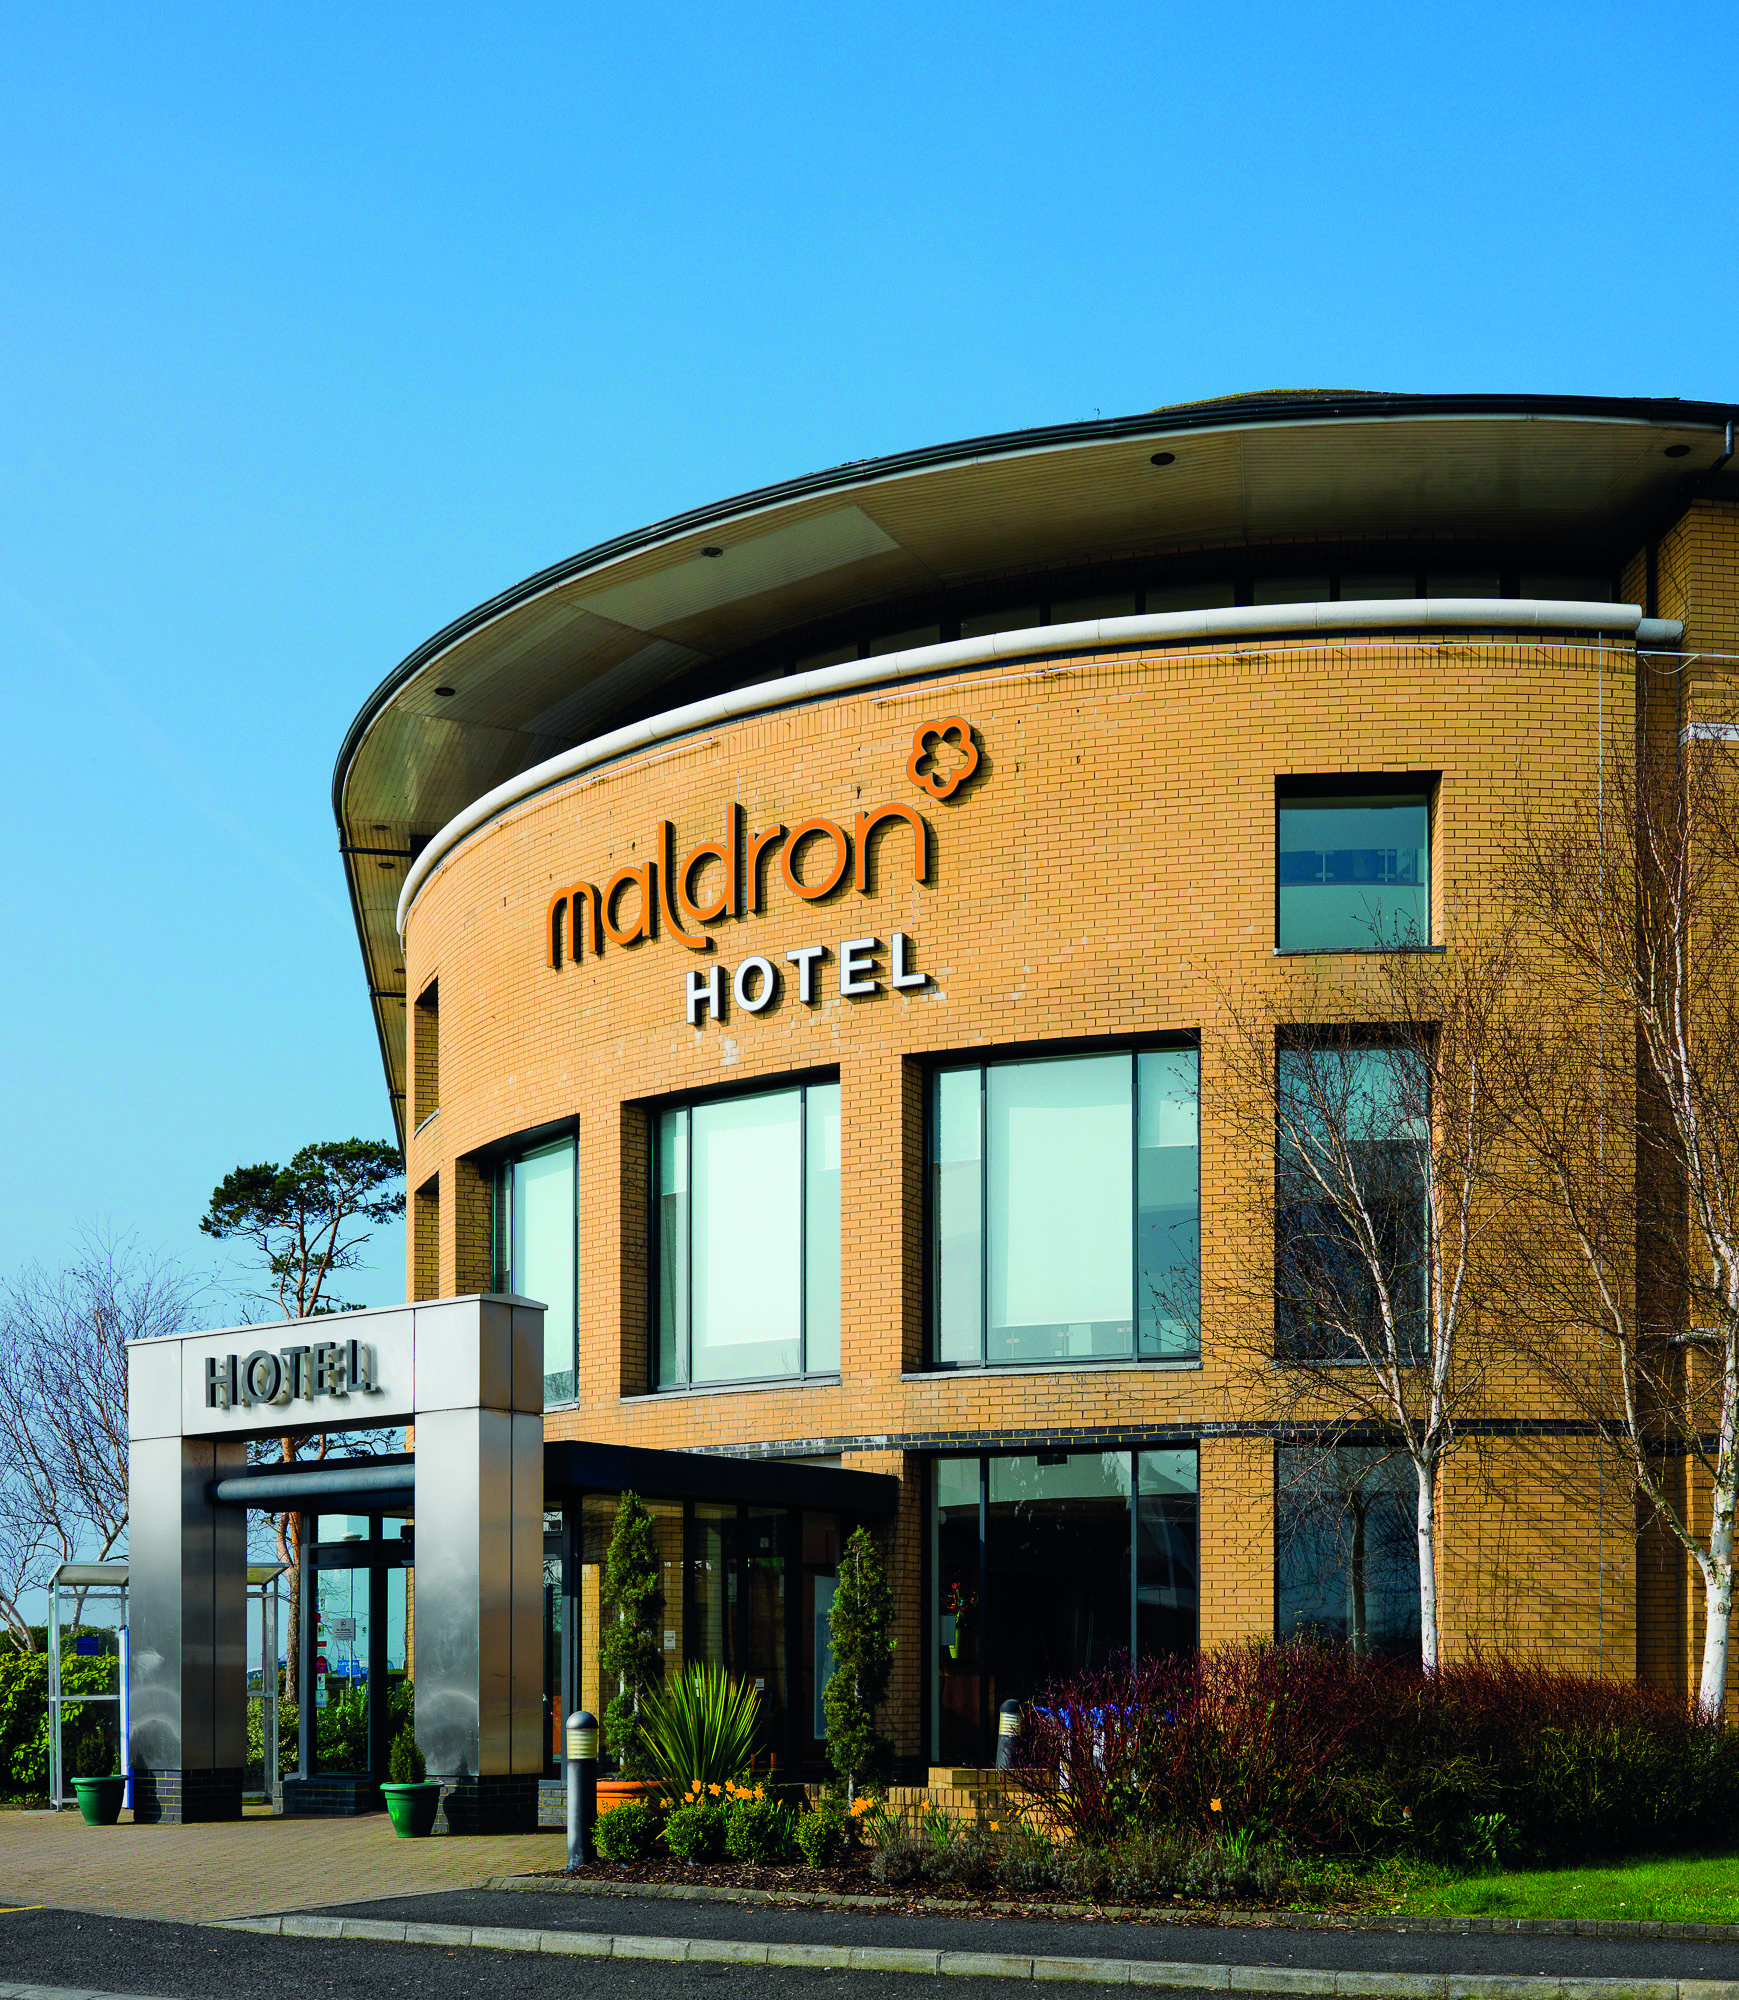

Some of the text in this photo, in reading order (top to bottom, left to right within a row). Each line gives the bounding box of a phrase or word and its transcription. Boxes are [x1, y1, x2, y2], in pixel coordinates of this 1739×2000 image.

[546, 803, 929, 969] maldron
[686, 933, 930, 1026] HOTEL
[205, 1339, 377, 1409] HOTEL
